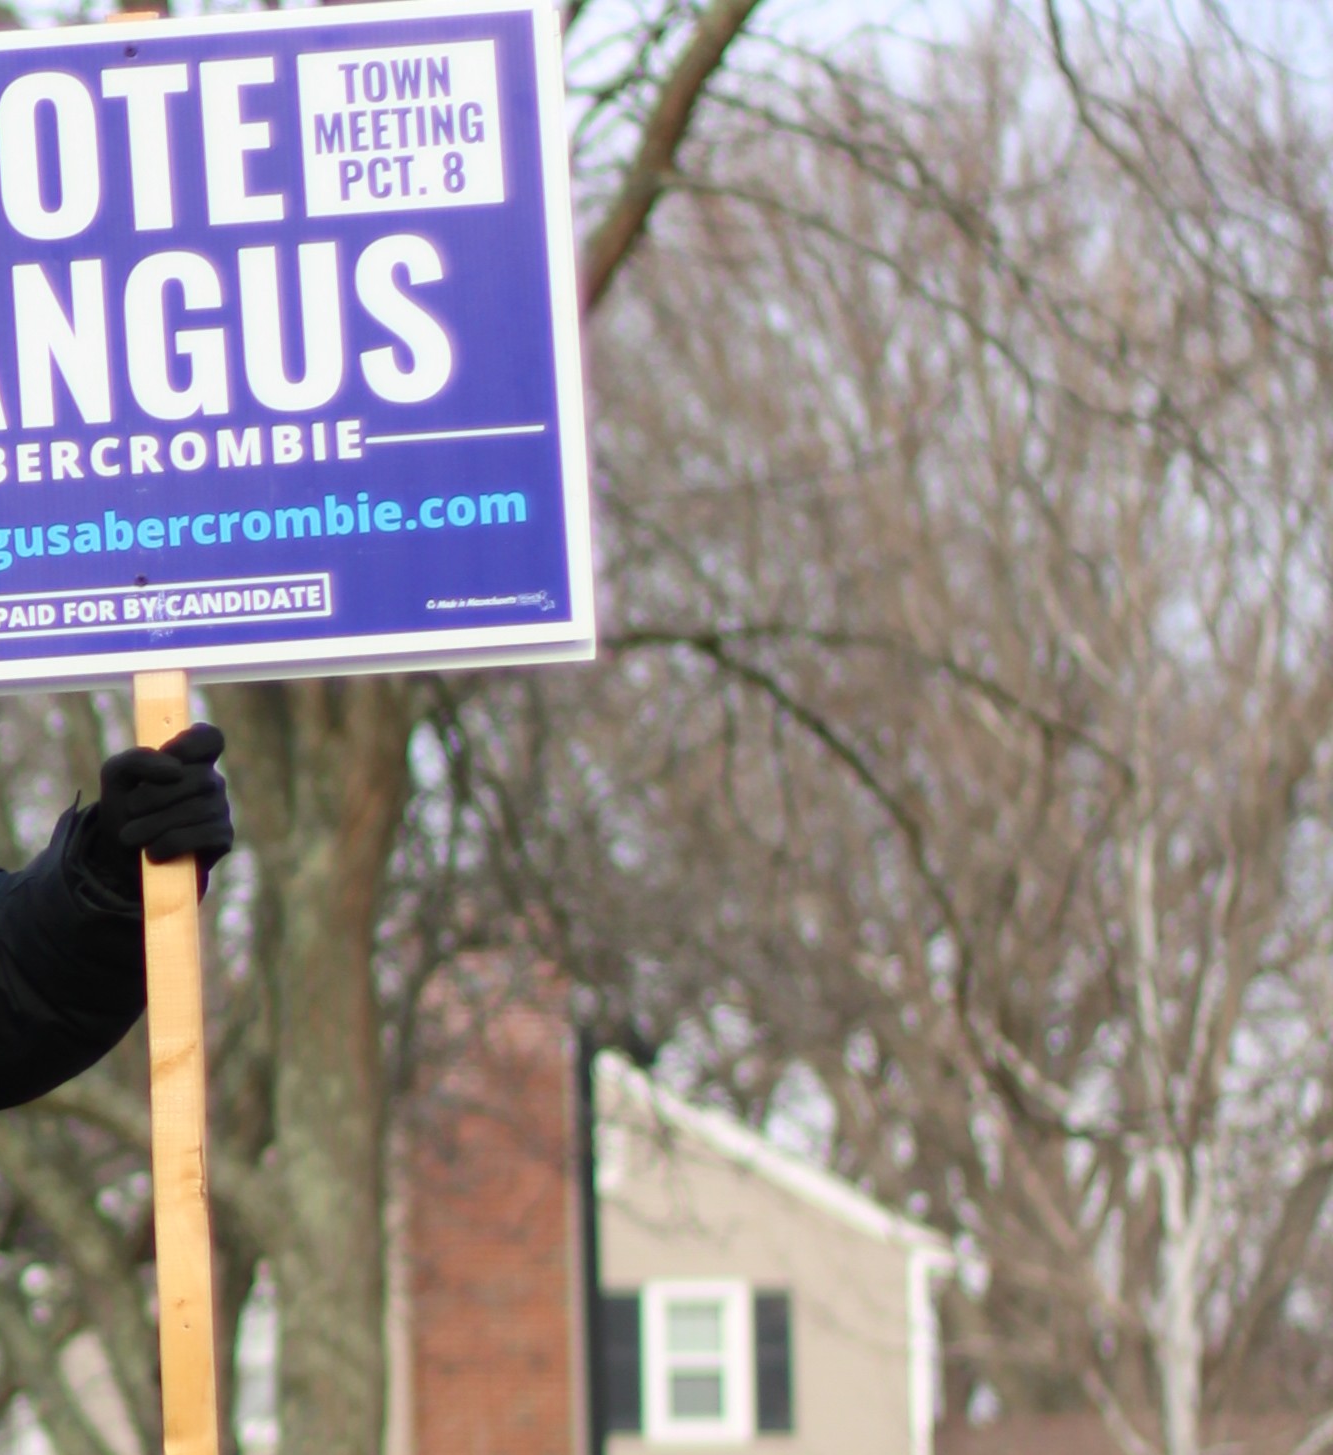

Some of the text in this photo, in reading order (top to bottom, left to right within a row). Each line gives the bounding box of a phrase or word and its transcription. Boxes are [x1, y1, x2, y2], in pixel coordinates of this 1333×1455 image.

[339, 56, 452, 103] TOWN
[314, 102, 485, 153] MEETING
[339, 151, 467, 201] PCT. 8
[63, 600, 116, 624] FOR
[123, 596, 159, 620] BY
[165, 584, 322, 617] CANDIDATE
